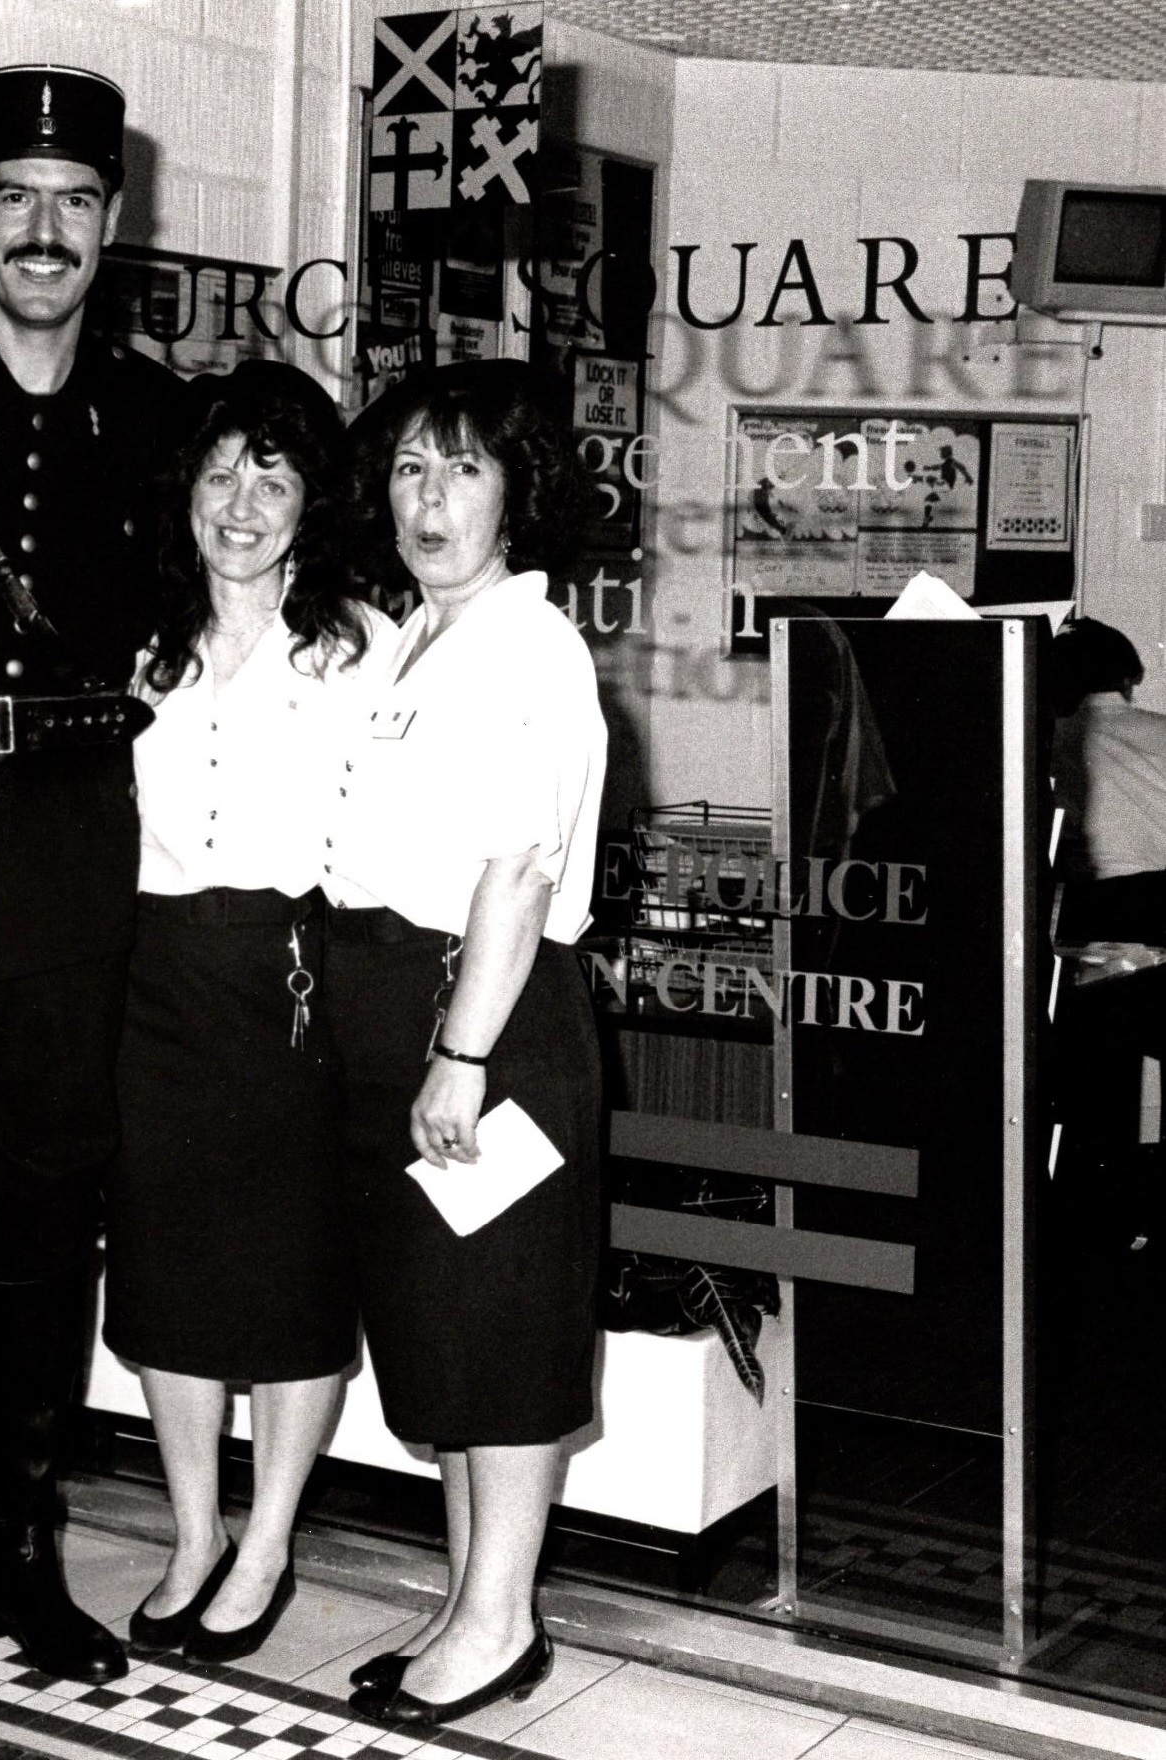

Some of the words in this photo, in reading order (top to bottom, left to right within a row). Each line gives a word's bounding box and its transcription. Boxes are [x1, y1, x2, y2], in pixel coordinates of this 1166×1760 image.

[586, 363, 615, 383] LOCK
[615, 367, 627, 386] IT
[598, 385, 615, 404] OR
[586, 402, 614, 425] LOSE
[664, 841, 930, 926] POLICE
[655, 959, 927, 1038] CENTRE
